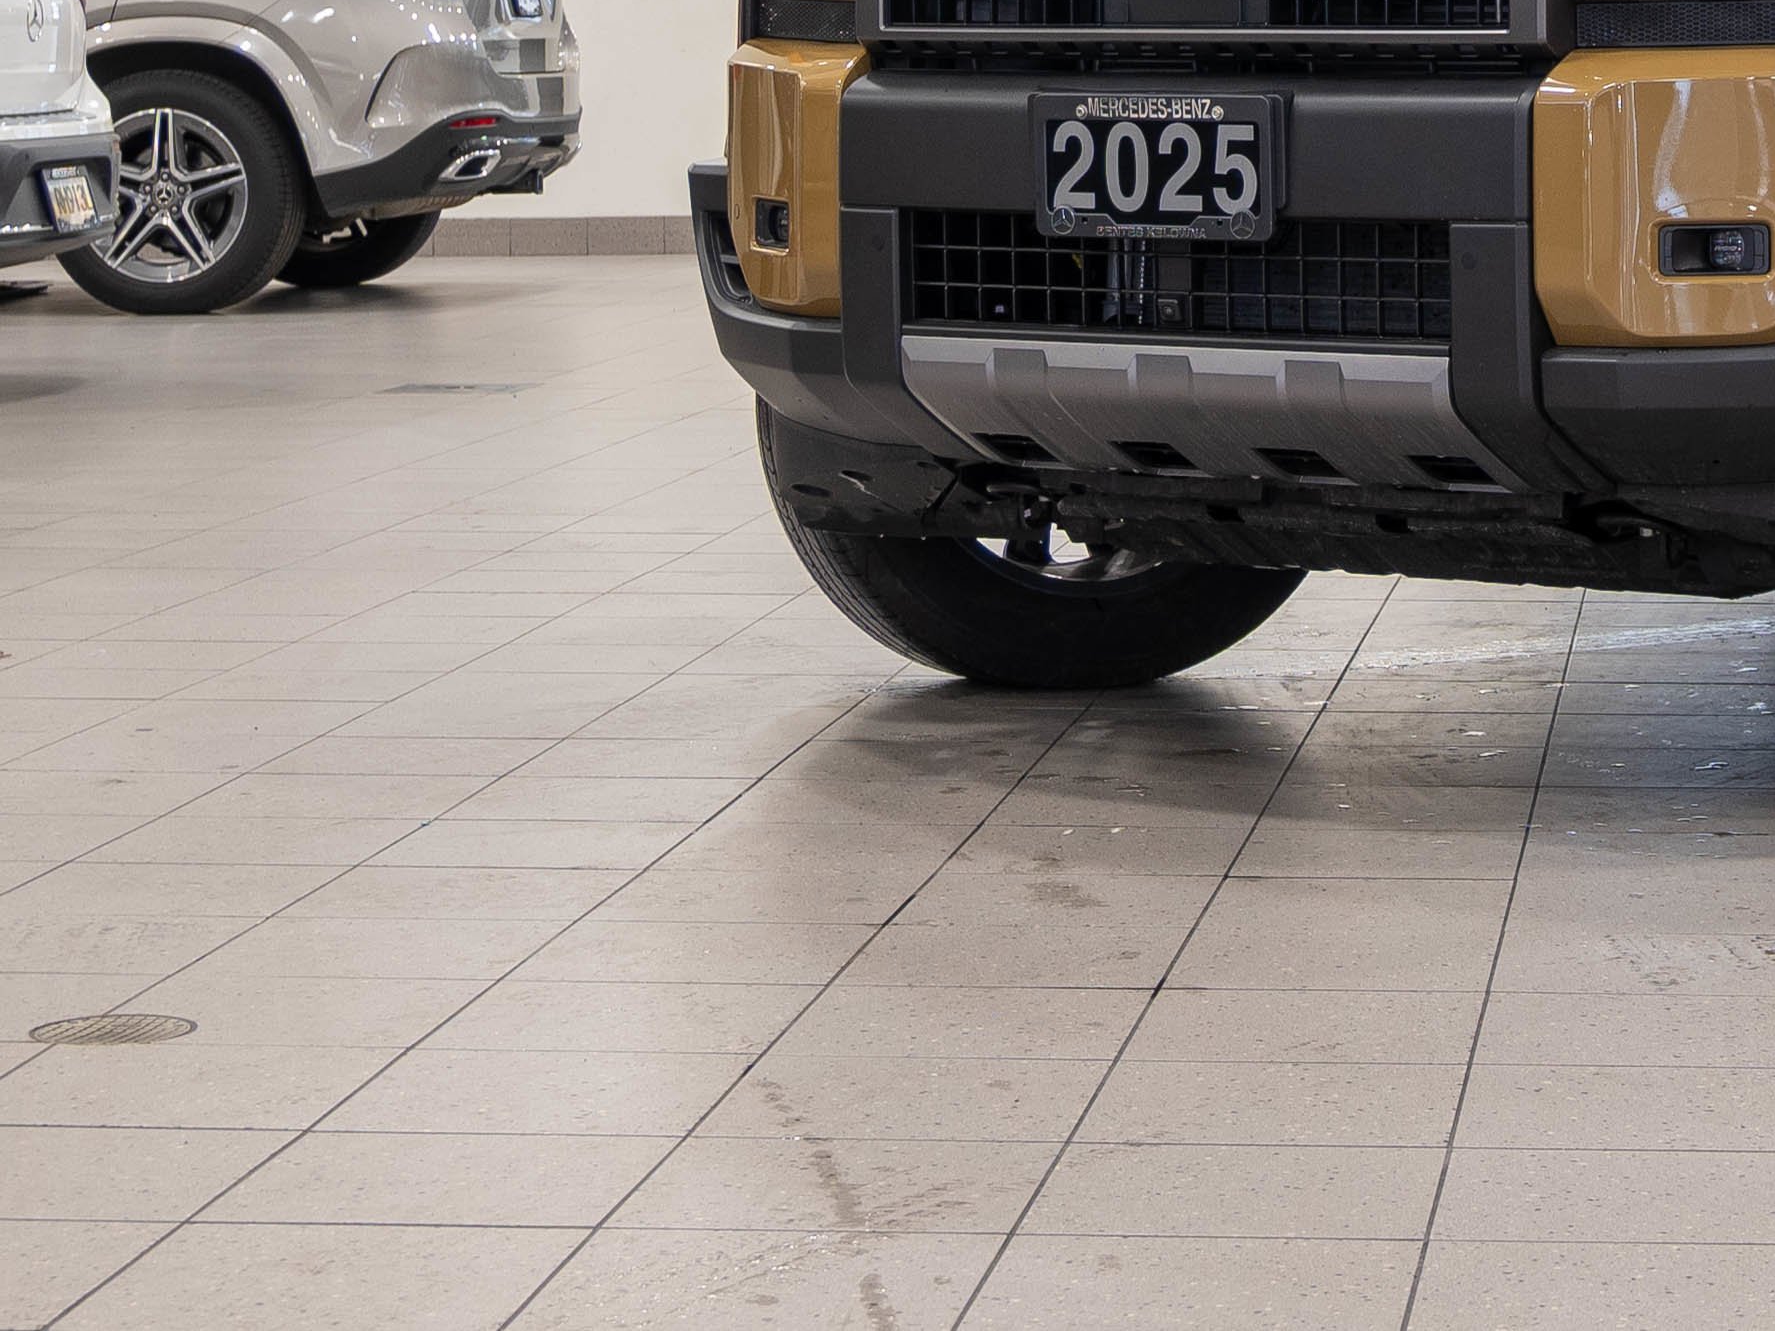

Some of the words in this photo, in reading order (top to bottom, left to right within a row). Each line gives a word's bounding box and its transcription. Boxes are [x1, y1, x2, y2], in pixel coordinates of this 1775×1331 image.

[1087, 97, 1212, 119] MERCEDES-BENZ
[1052, 120, 1258, 214] 2025
[1146, 226, 1207, 240] KELOWNA
